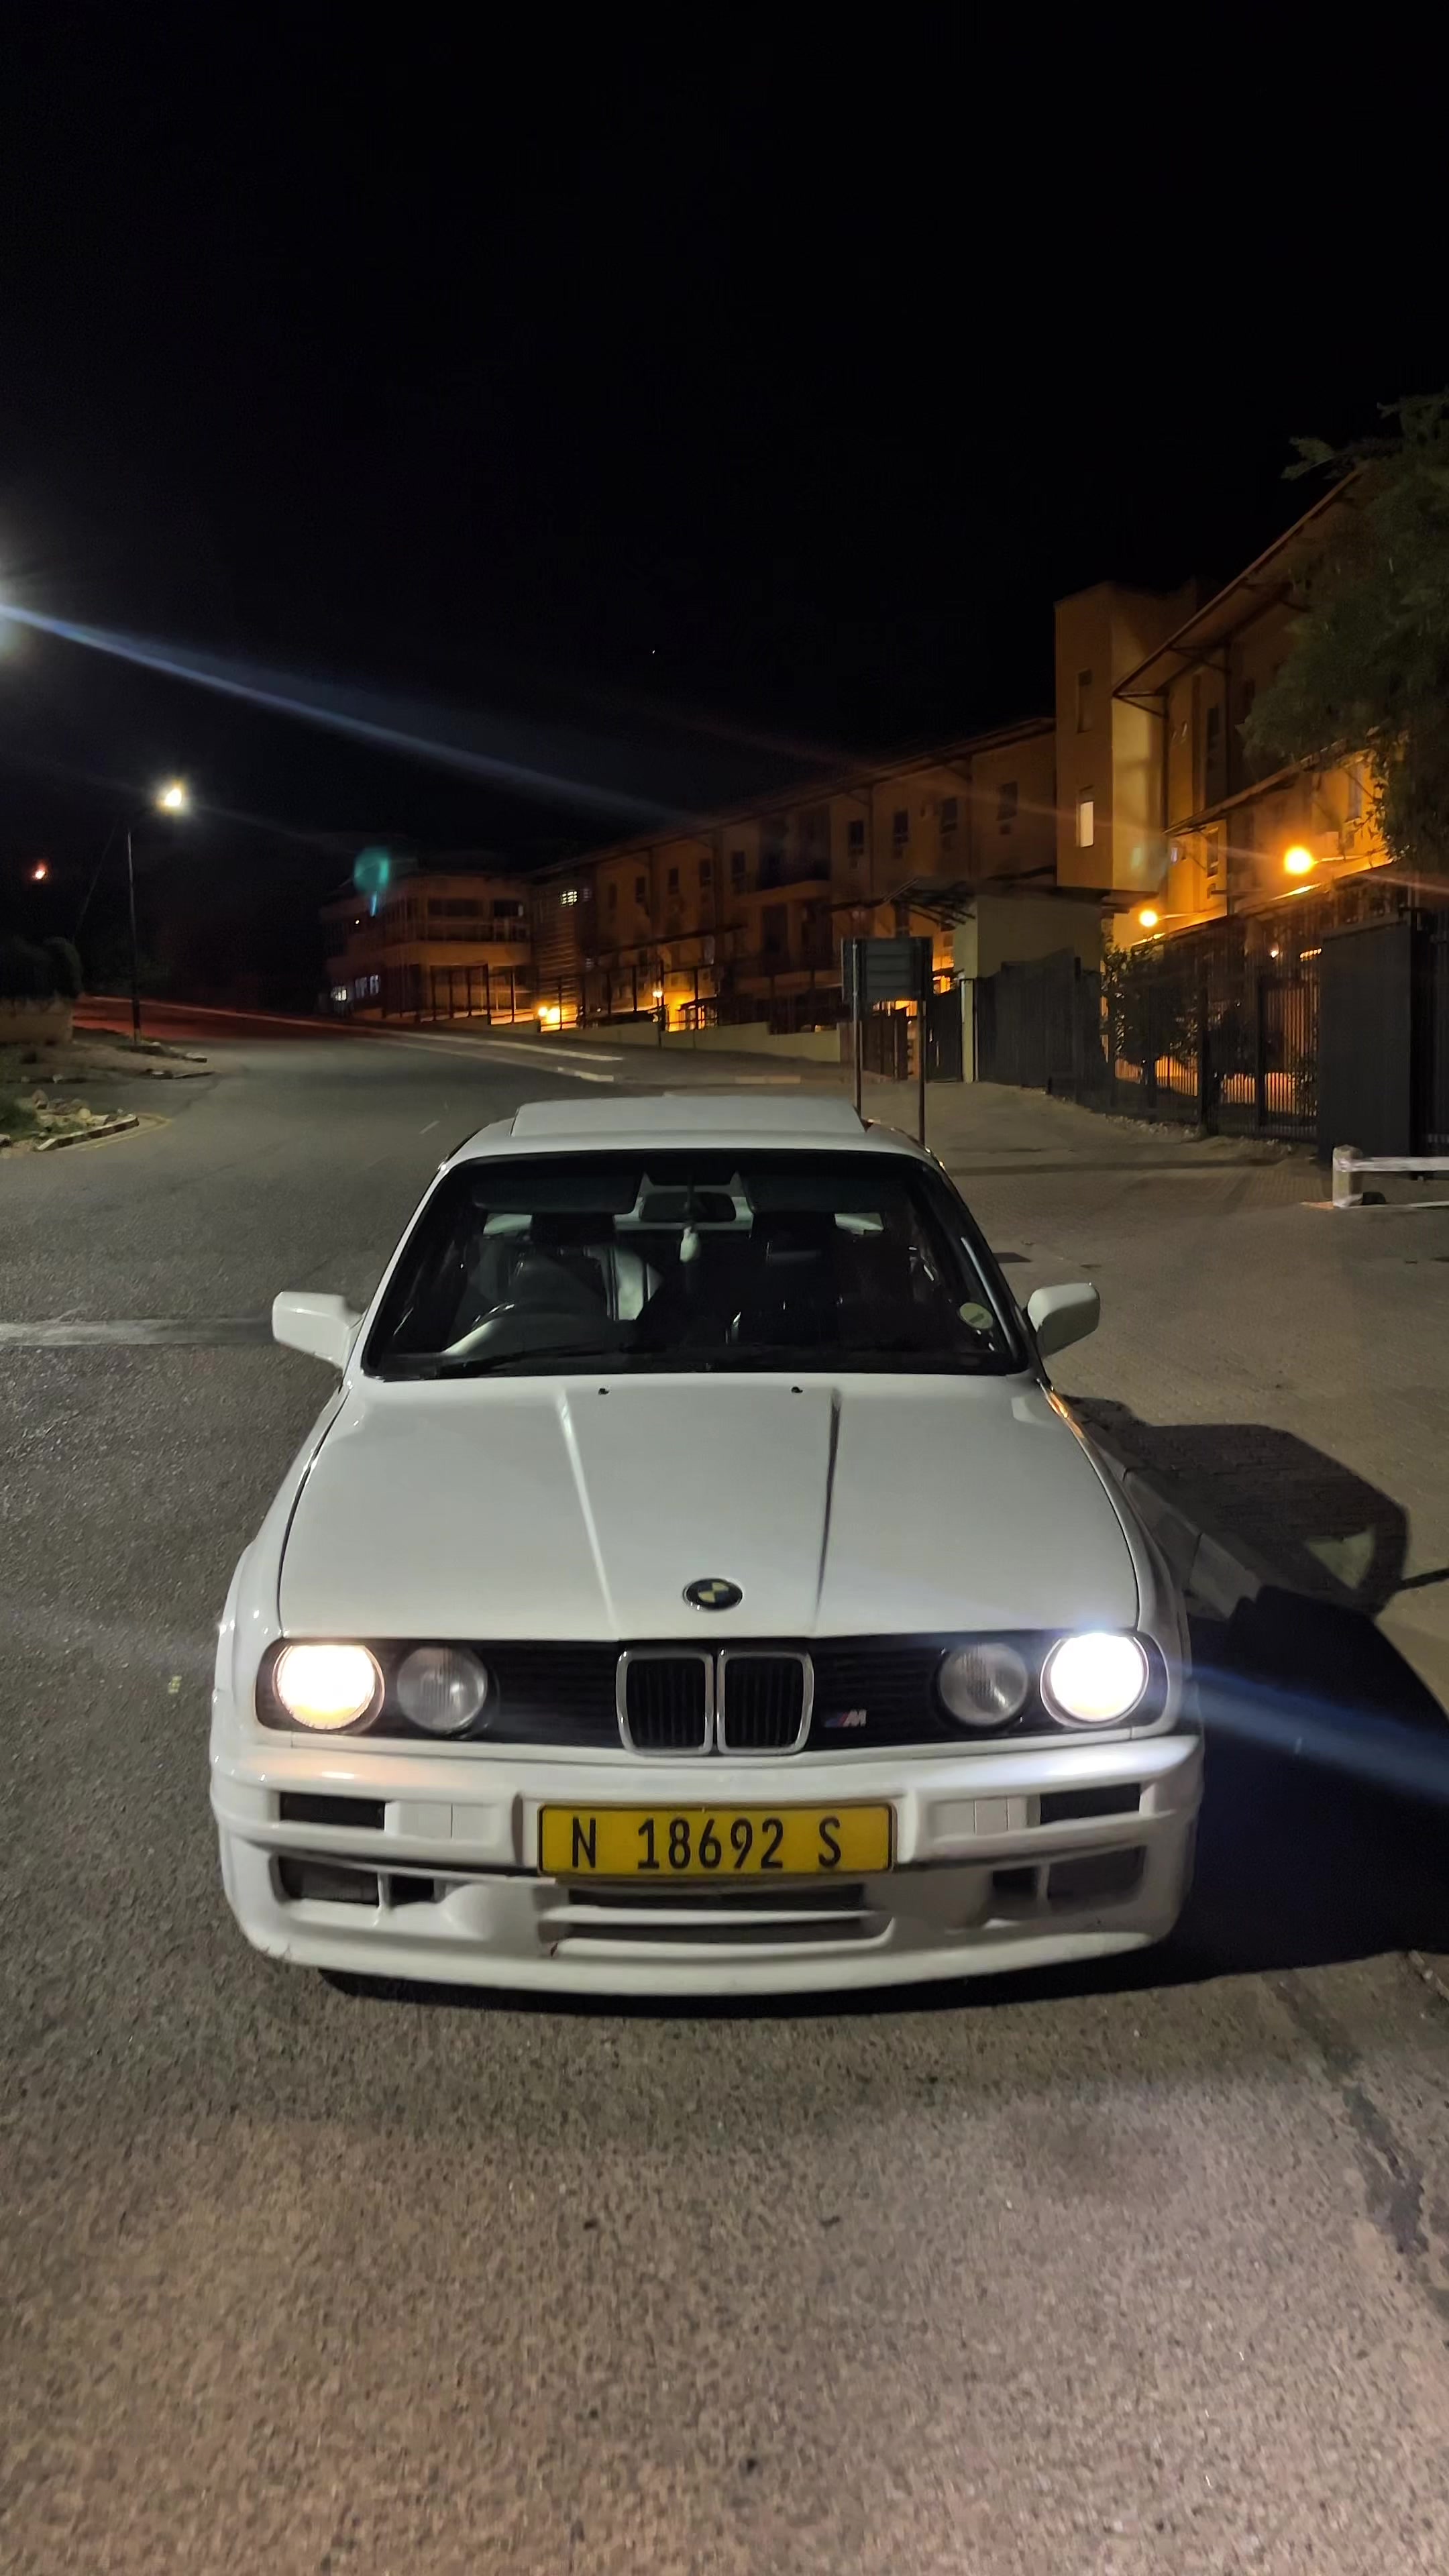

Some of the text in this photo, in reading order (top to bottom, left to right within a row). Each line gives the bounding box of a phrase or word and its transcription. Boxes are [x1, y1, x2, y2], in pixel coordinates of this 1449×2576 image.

[843, 1709, 867, 1727] M
[572, 1817, 842, 1870] N 18692 S
